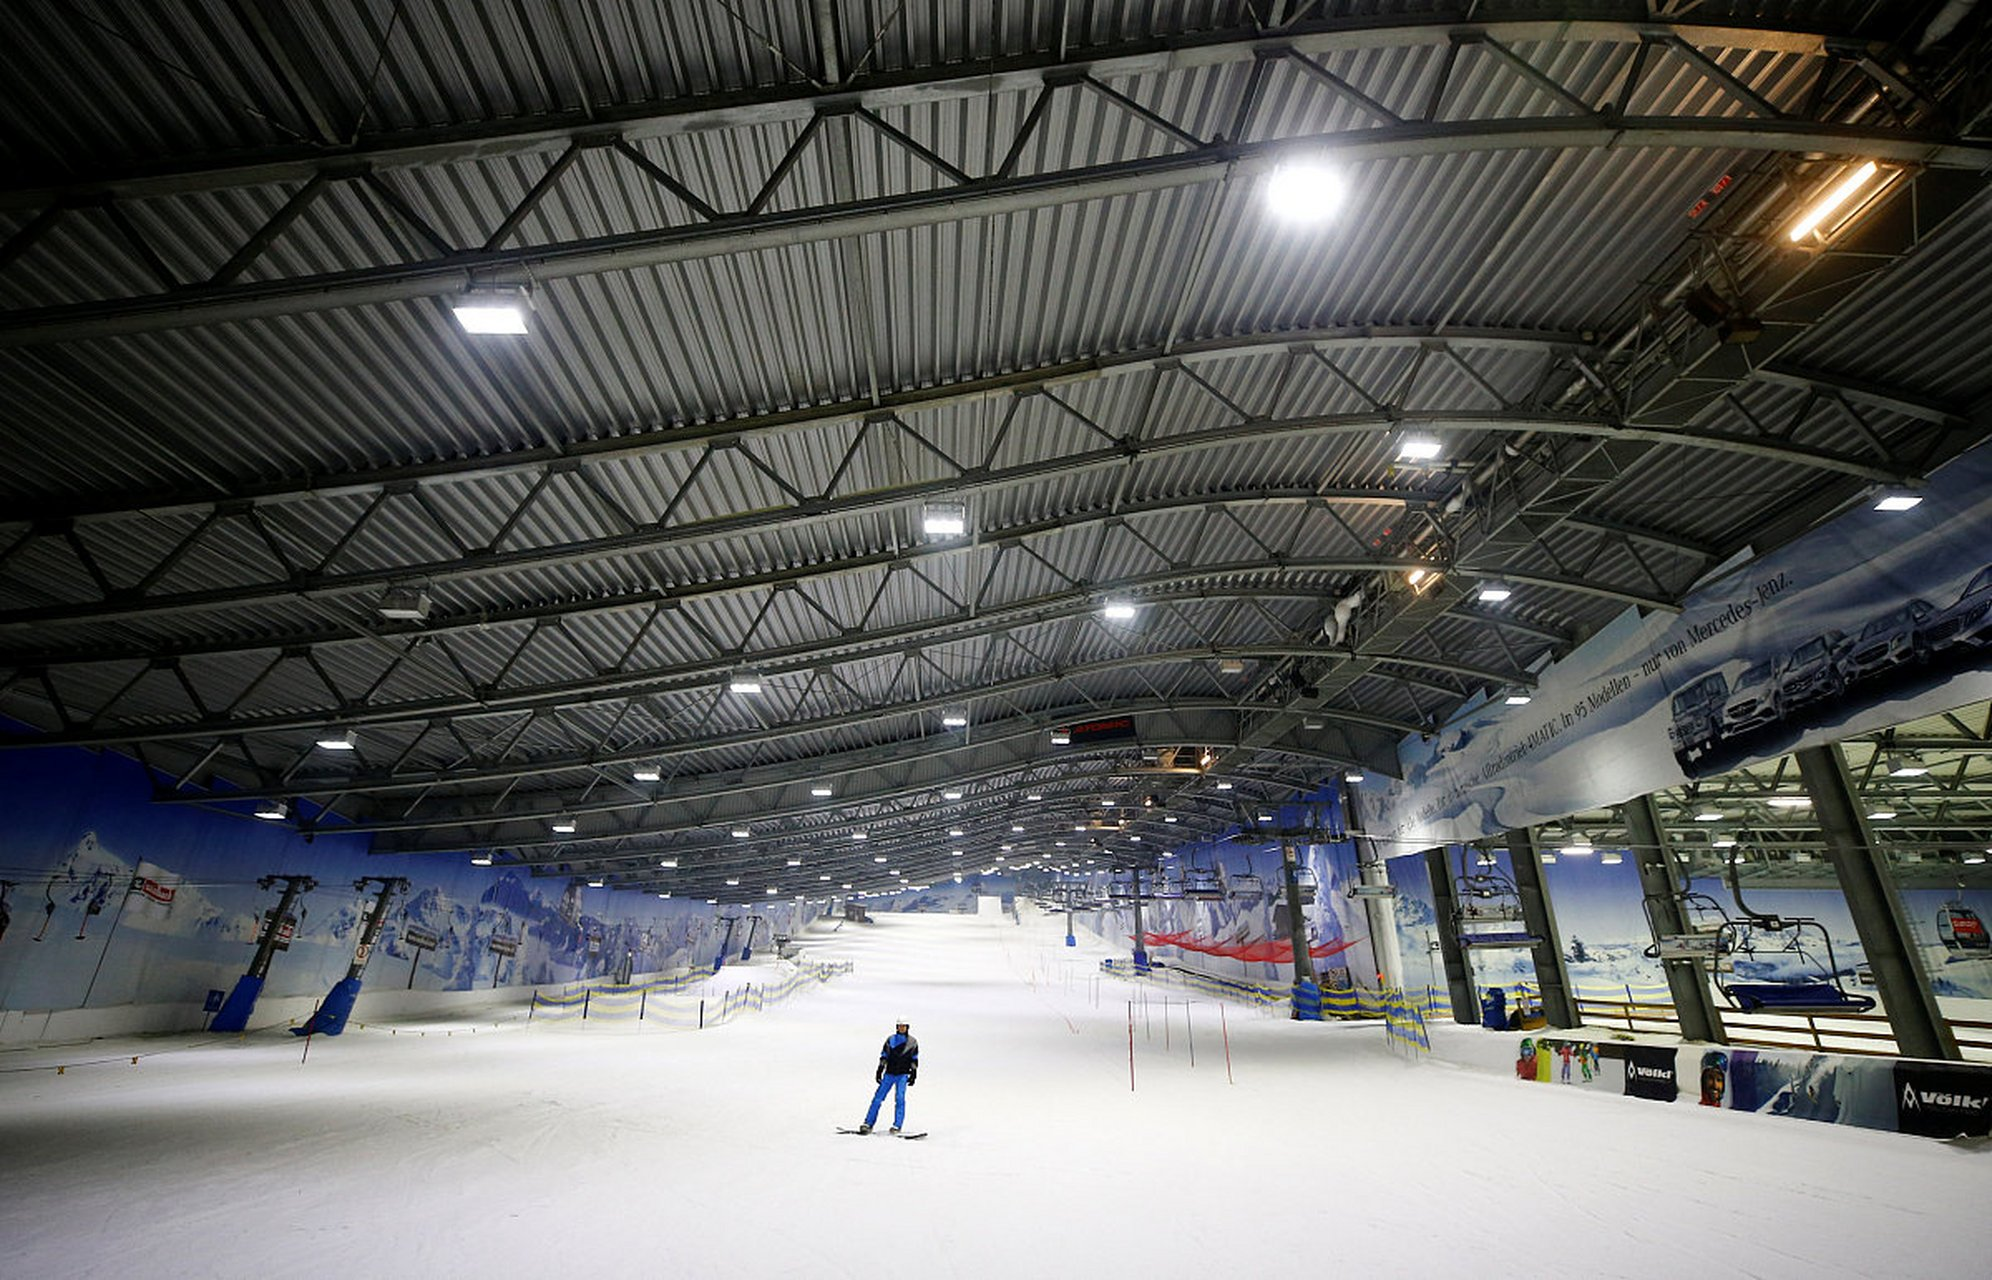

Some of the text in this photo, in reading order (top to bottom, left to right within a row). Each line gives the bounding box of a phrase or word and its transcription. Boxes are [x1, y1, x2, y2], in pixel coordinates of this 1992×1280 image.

[1560, 711, 1575, 728] In
[1574, 701, 1588, 719] 95
[1587, 675, 1631, 713] Modellen
[1641, 650, 1662, 676] nur
[1664, 640, 1687, 661] von
